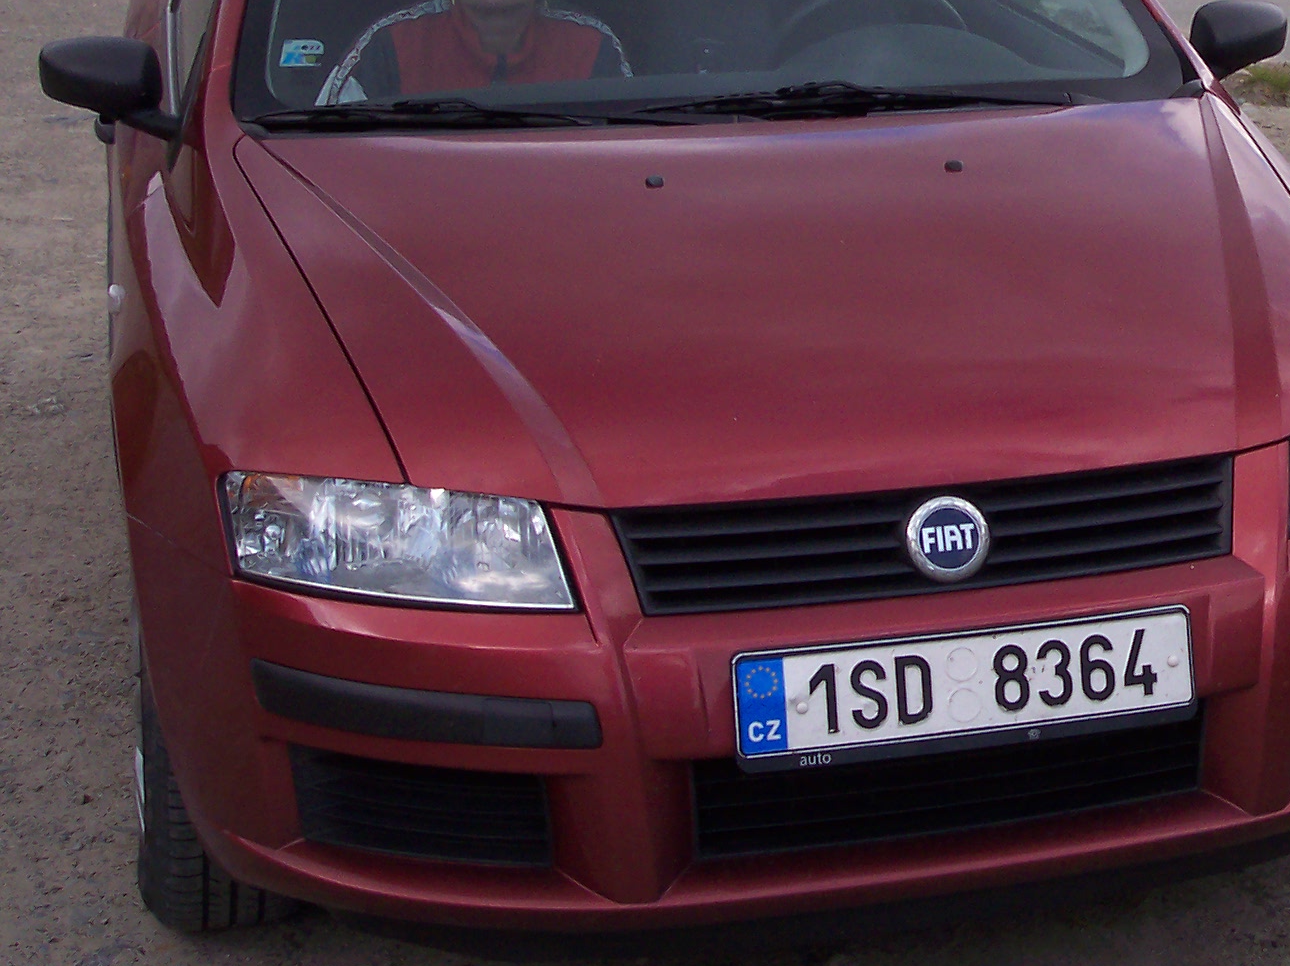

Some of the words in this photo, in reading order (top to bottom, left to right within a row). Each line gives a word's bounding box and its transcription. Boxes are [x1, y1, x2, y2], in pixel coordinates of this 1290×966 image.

[921, 522, 976, 554] FIAT
[808, 655, 934, 734] 1SD
[992, 628, 1158, 712] 8364
[748, 719, 782, 742] CZ
[799, 752, 832, 766] auto
